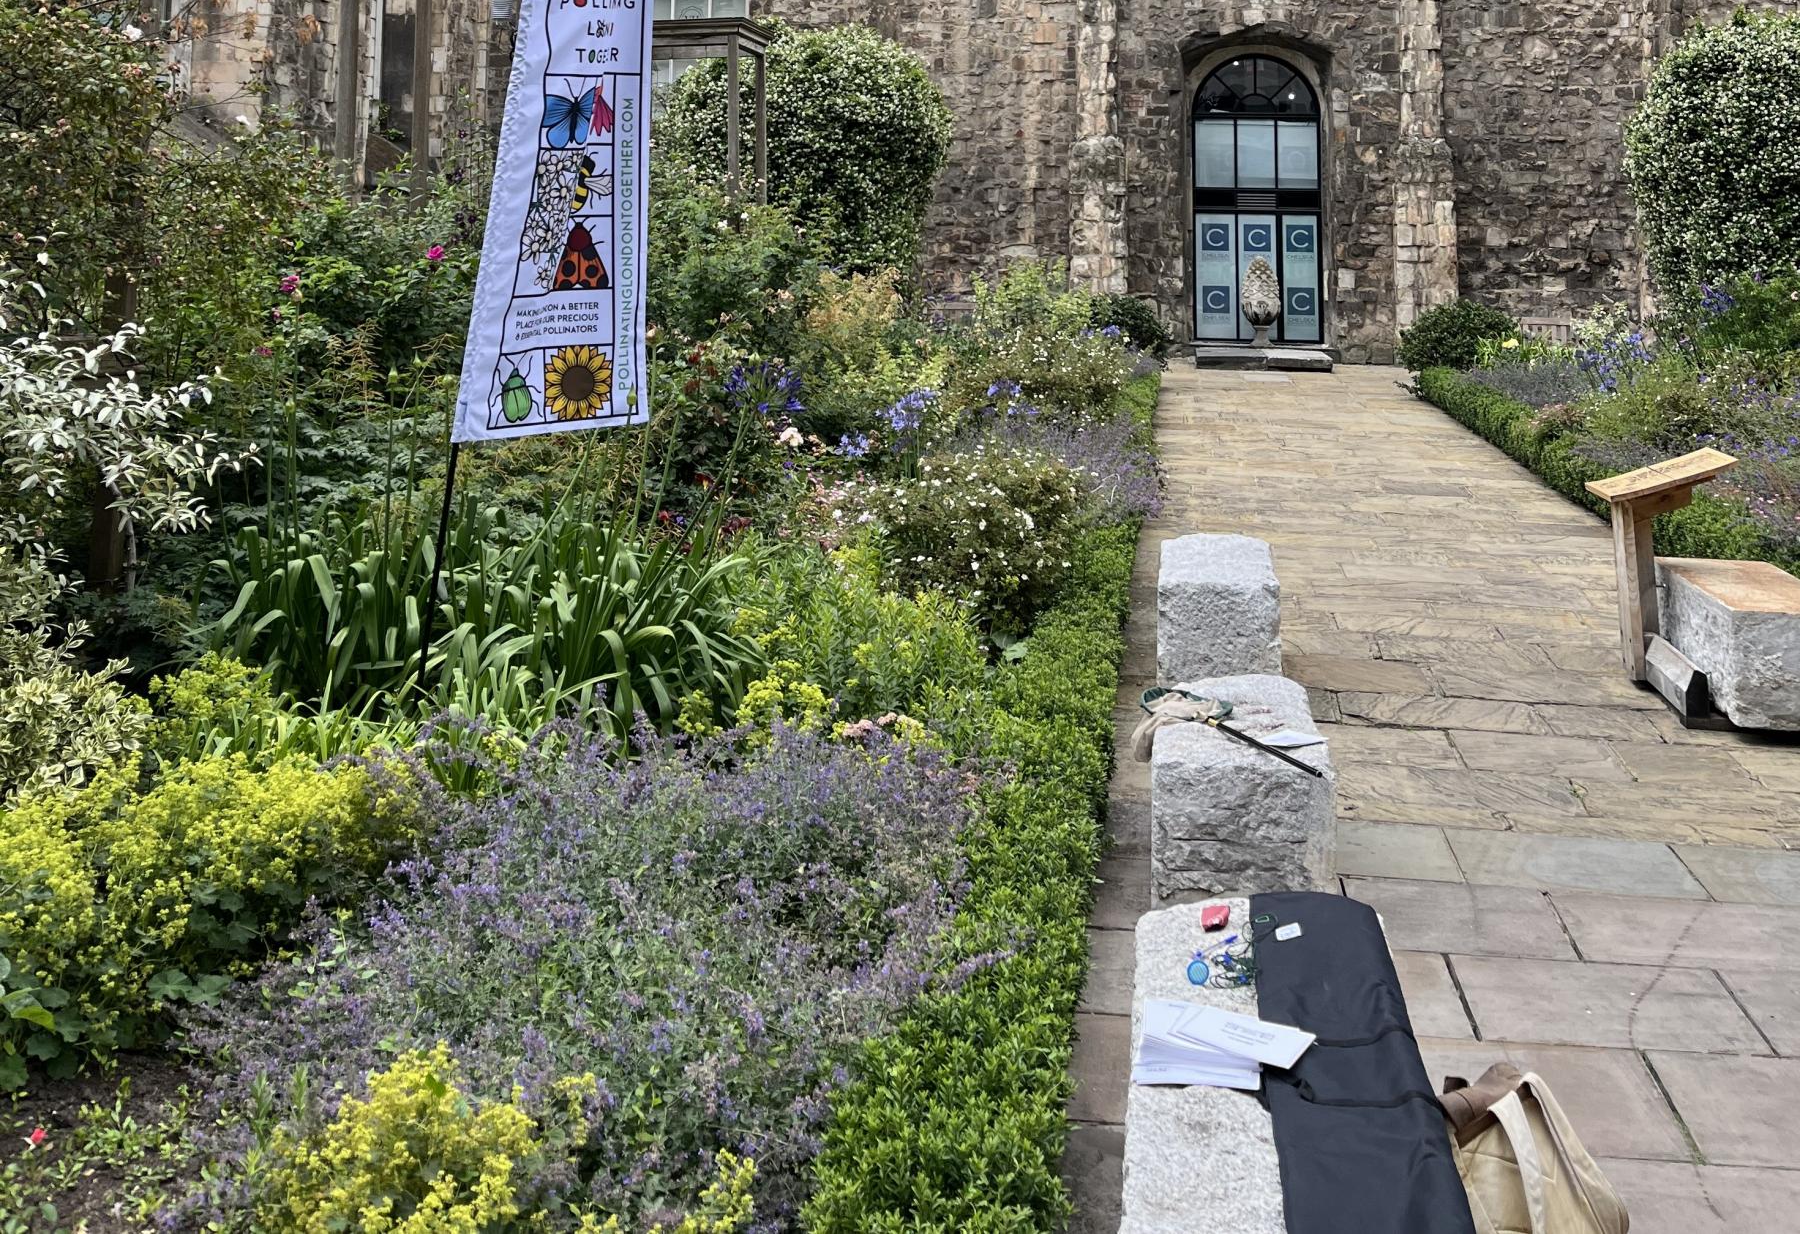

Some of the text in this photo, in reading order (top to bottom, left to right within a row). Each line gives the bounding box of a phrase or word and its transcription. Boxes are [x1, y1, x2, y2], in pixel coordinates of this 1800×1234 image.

[618, 98, 634, 391] POLLINATINGLONDONTOGETHER.COM
[568, 302, 599, 311] BETTER
[542, 315, 555, 324] OUR
[557, 313, 599, 323] PRECIOUS
[543, 324, 598, 335] POLLINATORS
